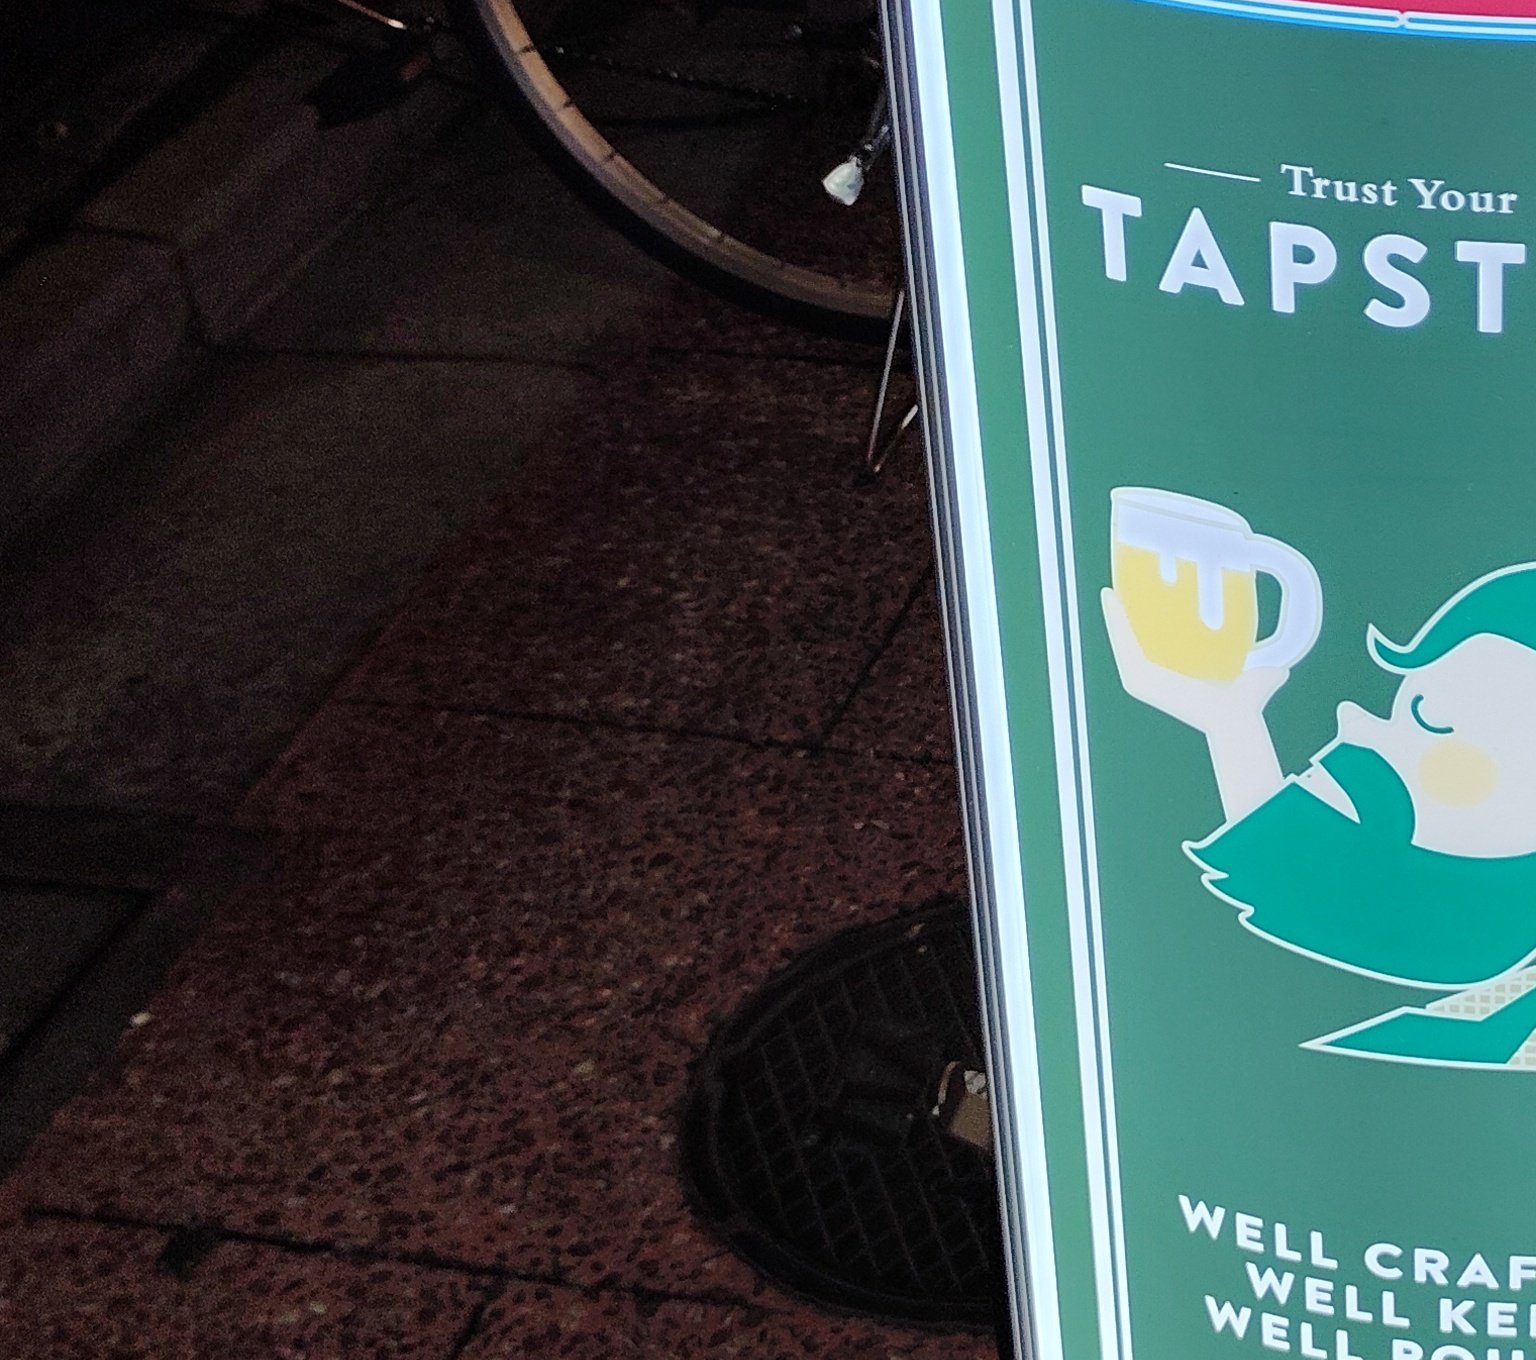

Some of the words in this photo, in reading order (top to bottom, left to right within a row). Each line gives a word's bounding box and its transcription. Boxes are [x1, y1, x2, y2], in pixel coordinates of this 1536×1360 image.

[1280, 163, 1398, 207] Trust
[1407, 177, 1519, 215] Your
[1178, 1194, 1339, 1270] WELL
[1245, 1261, 1411, 1329] WELL
